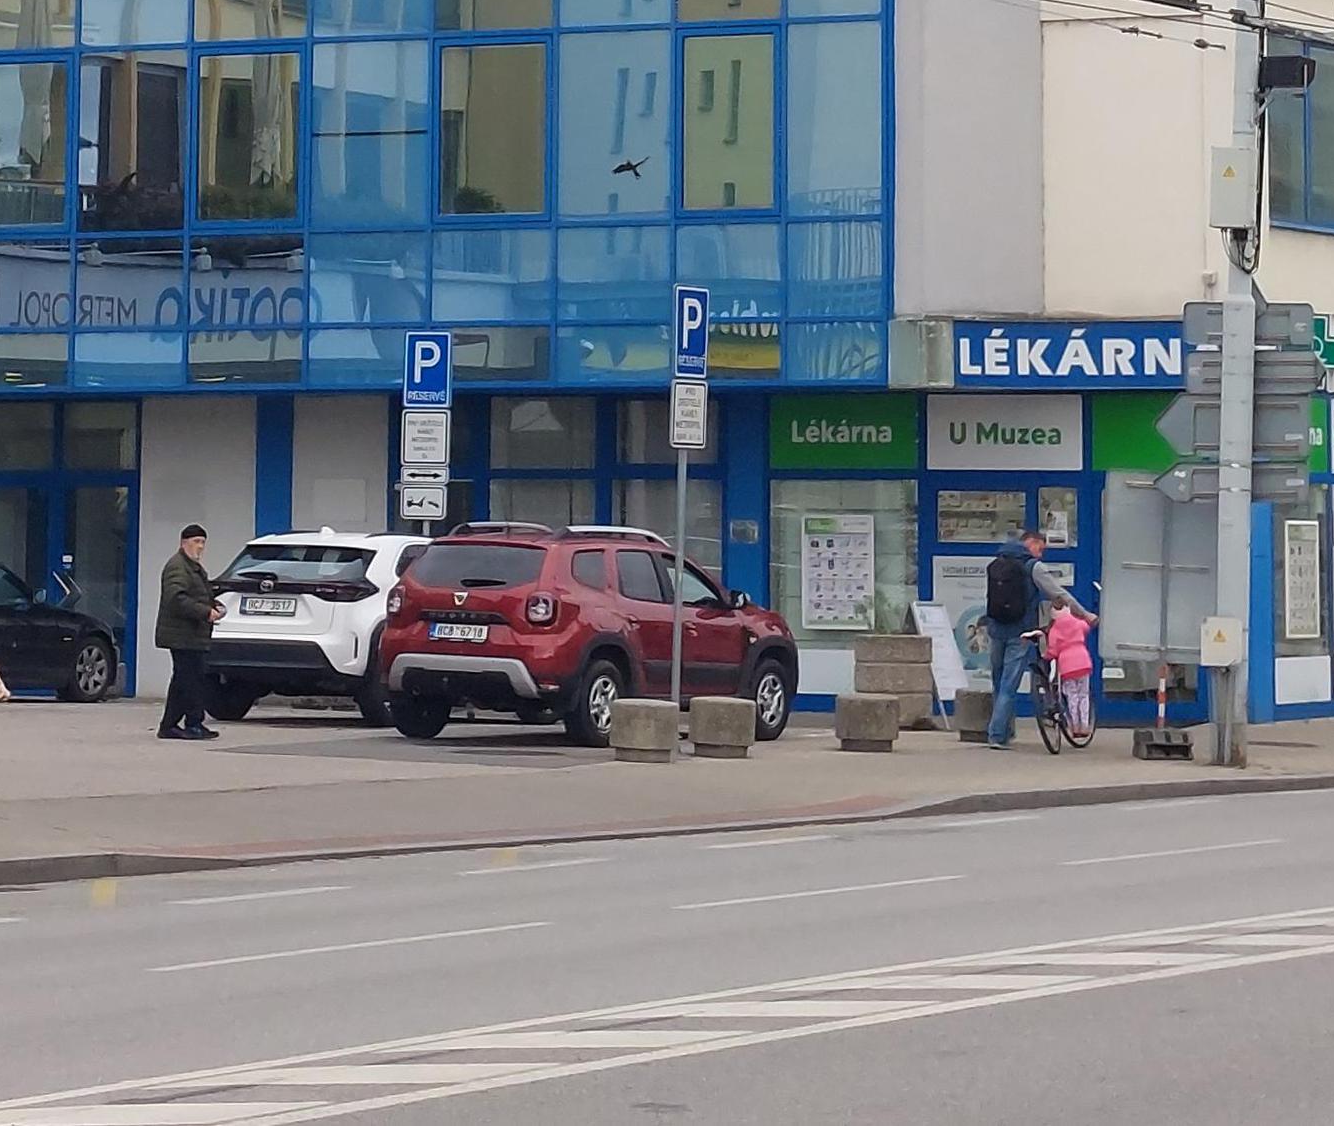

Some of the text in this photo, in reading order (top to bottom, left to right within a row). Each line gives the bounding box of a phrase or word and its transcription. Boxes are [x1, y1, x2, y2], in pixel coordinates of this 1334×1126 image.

[683, 297, 702, 349] P
[414, 340, 441, 383] P
[791, 419, 893, 444] Lékárna
[949, 422, 1062, 446] U Muzea
